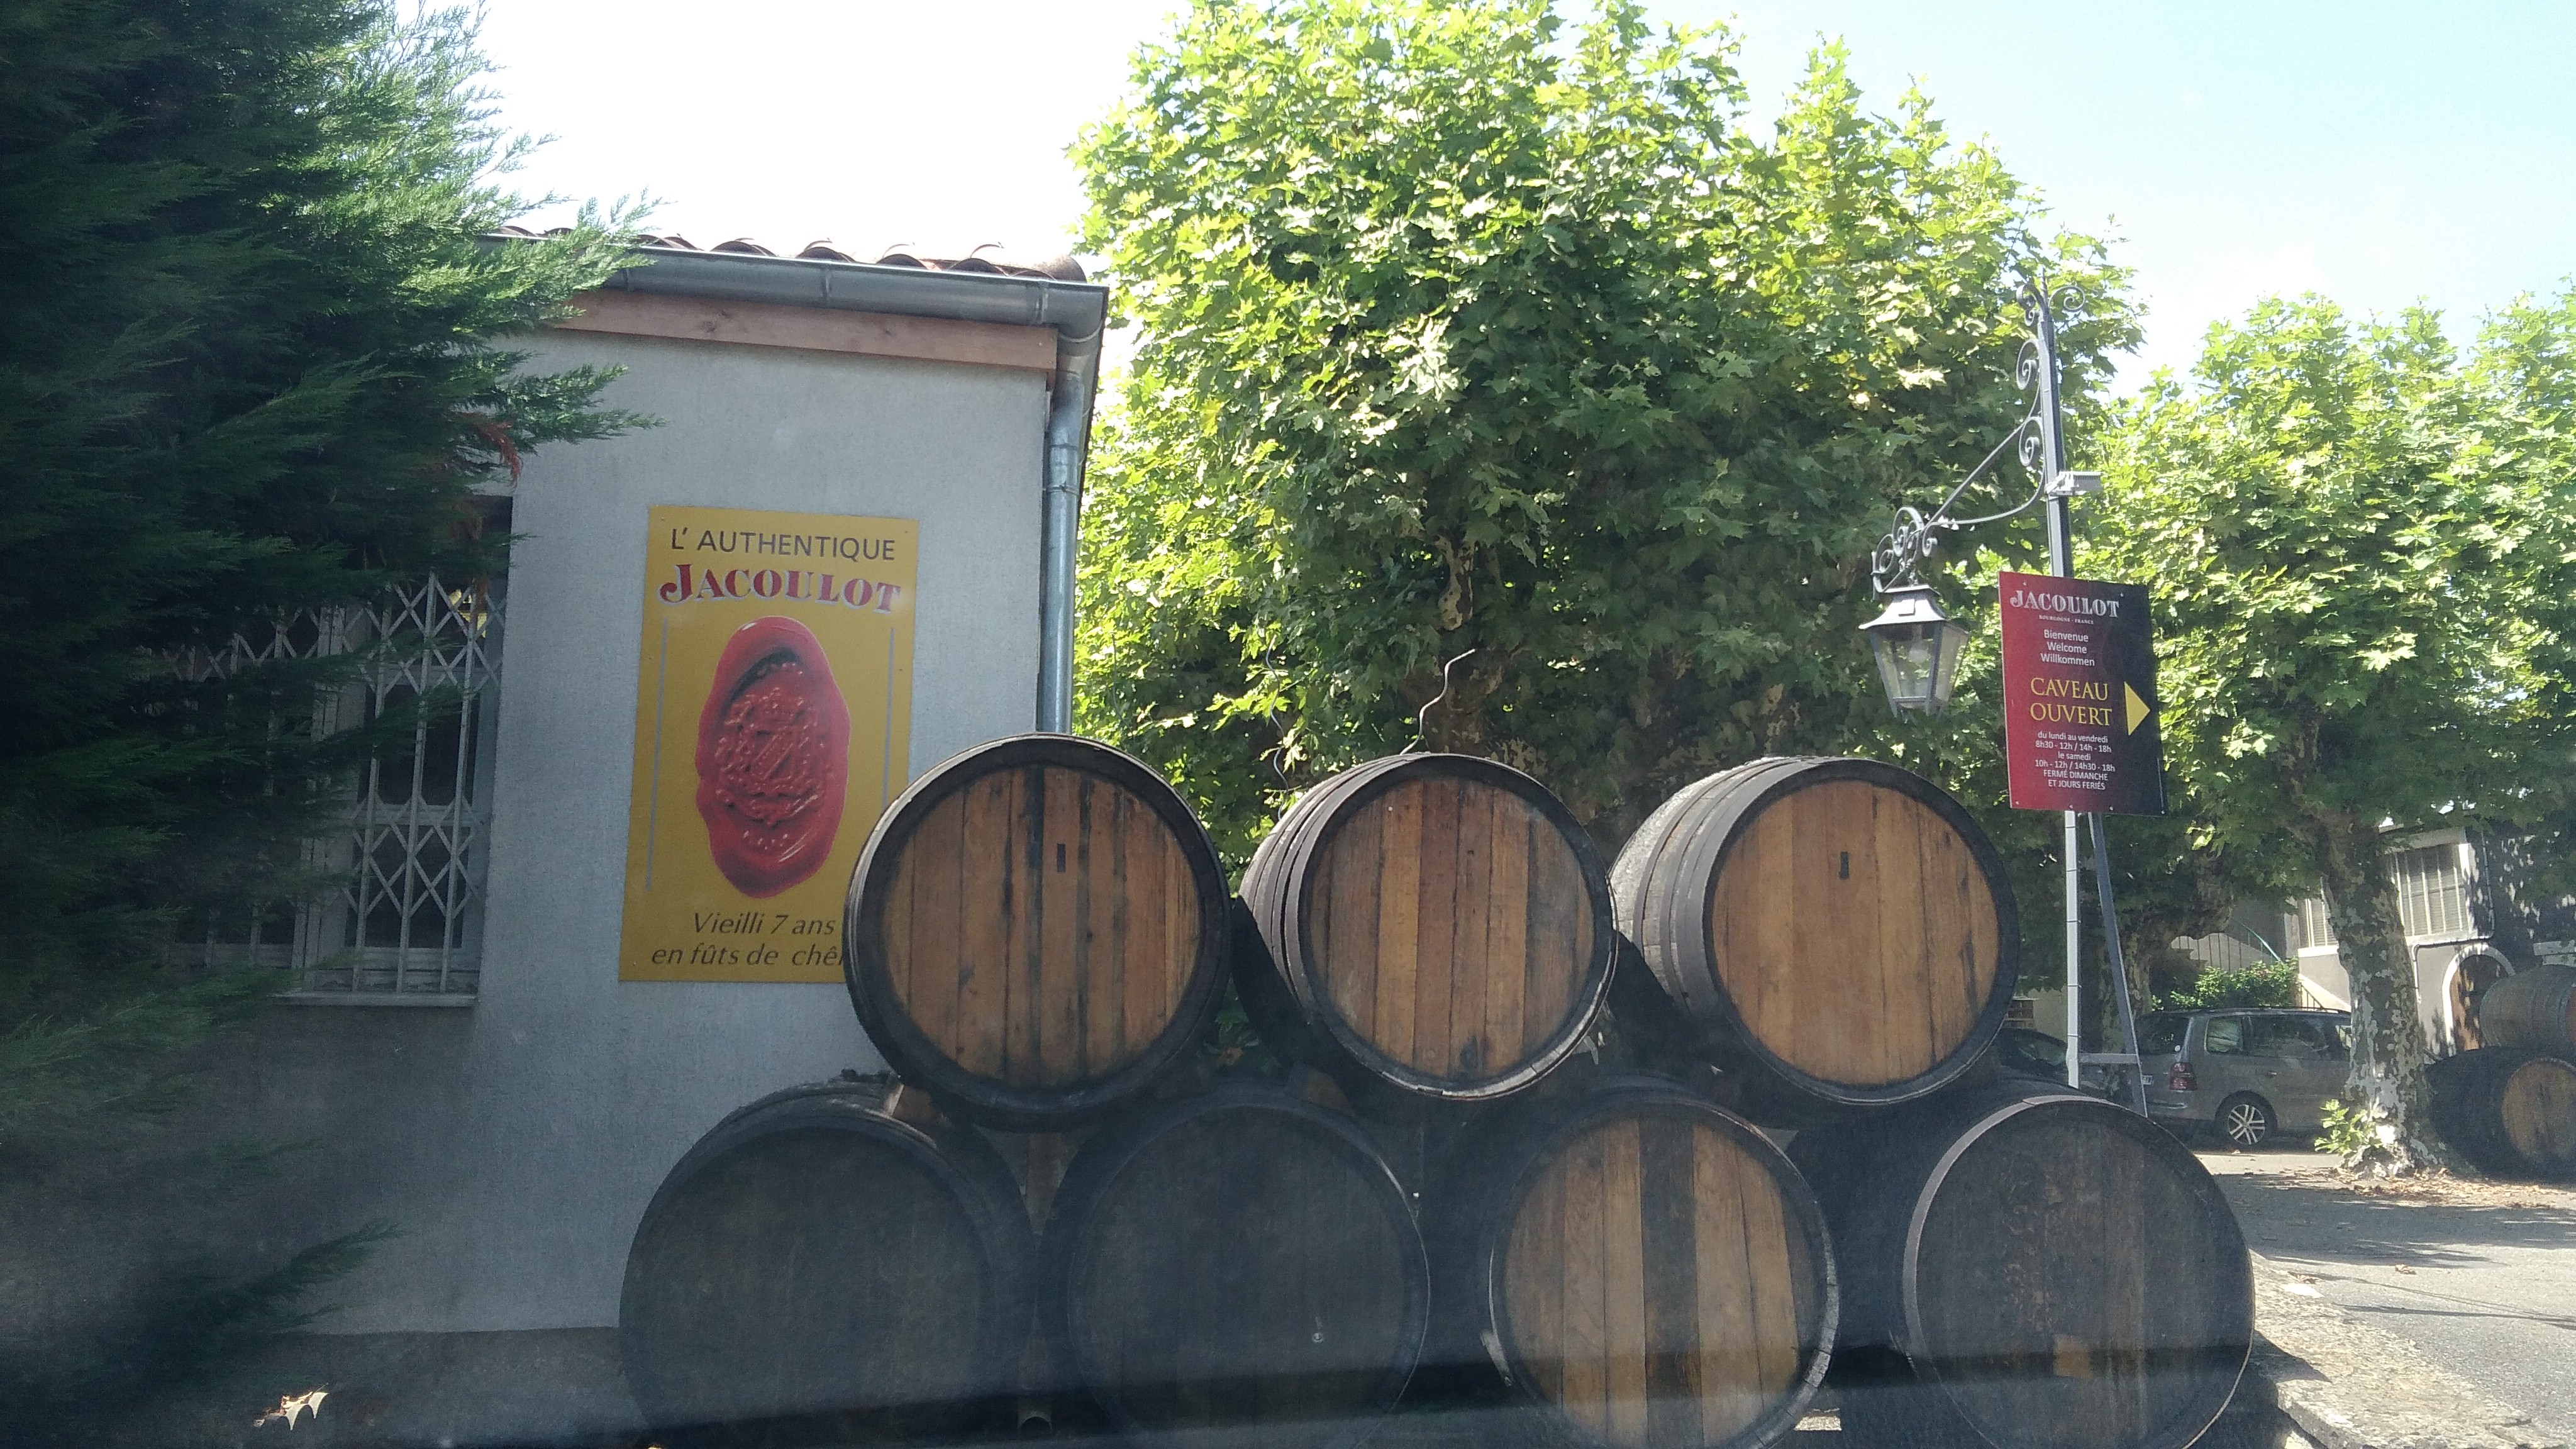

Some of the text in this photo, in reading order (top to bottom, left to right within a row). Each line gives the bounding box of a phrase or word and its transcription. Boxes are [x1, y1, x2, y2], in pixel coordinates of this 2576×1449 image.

[657, 564, 901, 614] JACOULOT
[2009, 590, 2119, 618] JACOULOT
[2044, 629, 2089, 641] Bienvenue
[2046, 641, 2087, 653] Welcome
[2040, 653, 2095, 666] Willkommen
[2030, 677, 2109, 701] CAVEAU
[2029, 702, 2112, 726] OUVERT
[2048, 731, 2066, 740] lundi
[2078, 735, 2109, 743] vendredi
[2035, 740, 2053, 748] 8h30
[2079, 743, 2092, 752] 14h
[2035, 759, 2048, 767] 10h
[2055, 760, 2068, 769] 12h
[2074, 762, 2096, 770] 14h30
[2043, 769, 2108, 780] FERMÉ DIMANCHE
[2058, 780, 2080, 789] JOURS
[693, 912, 836, 935] Vieilli 7 ans
[651, 942, 843, 965] en fûts de chê
